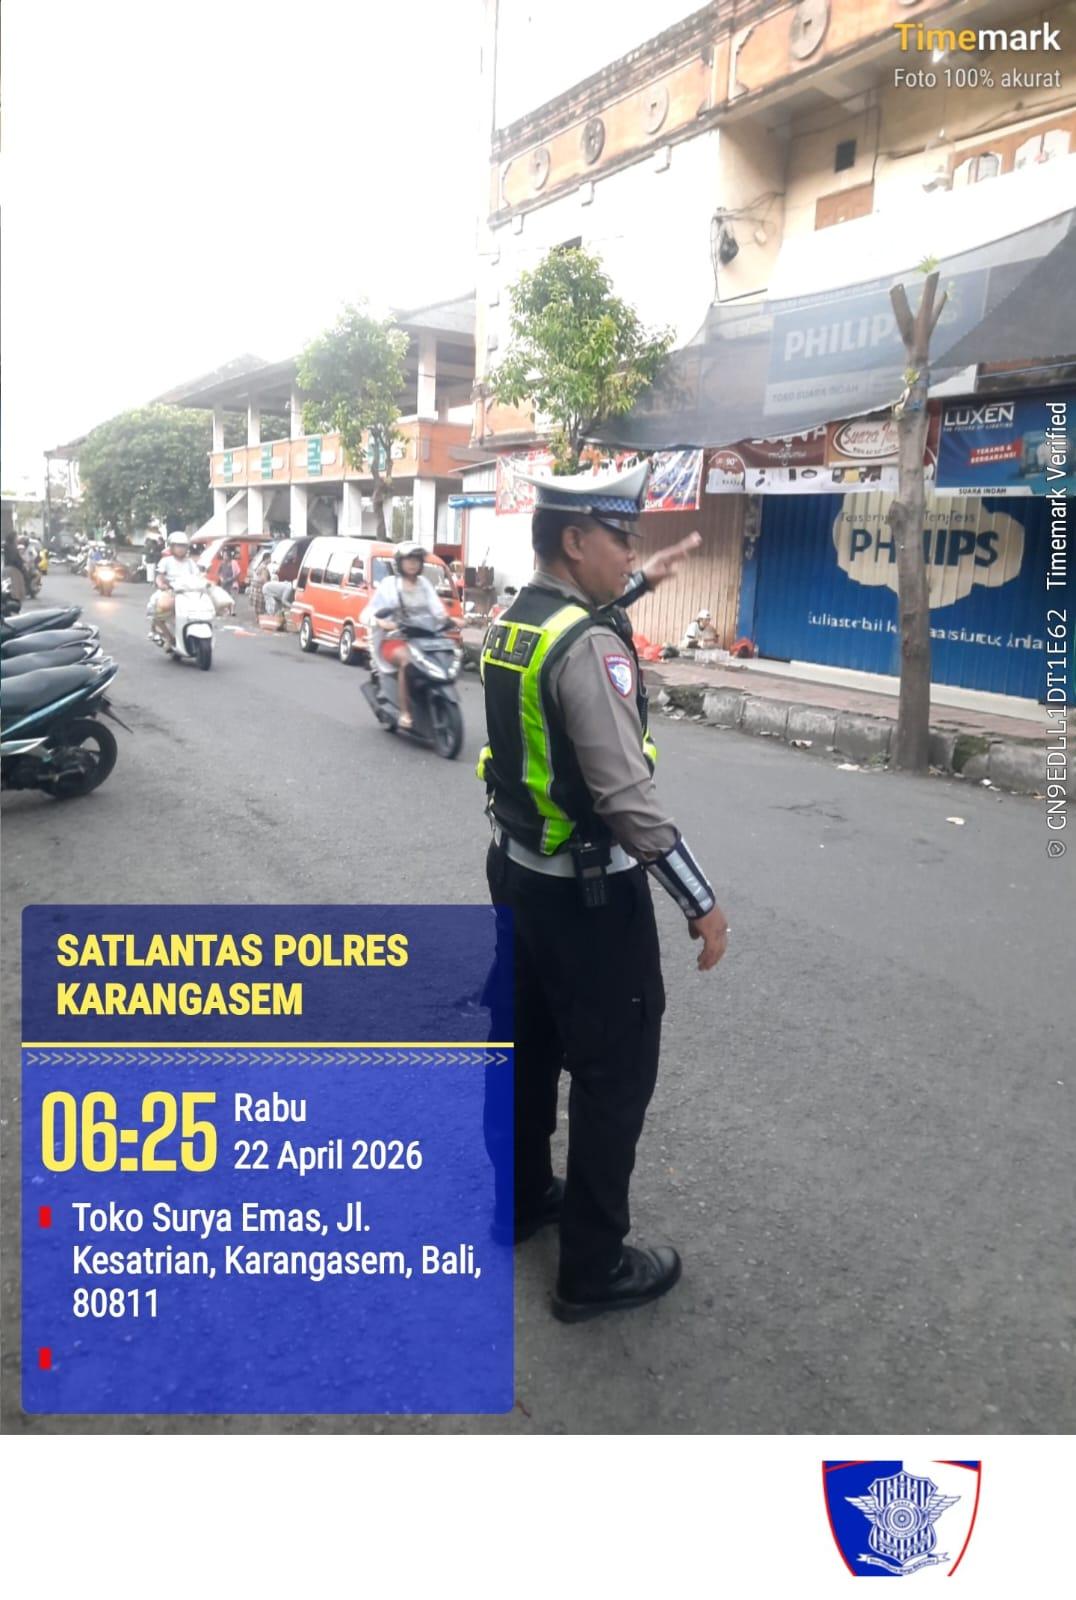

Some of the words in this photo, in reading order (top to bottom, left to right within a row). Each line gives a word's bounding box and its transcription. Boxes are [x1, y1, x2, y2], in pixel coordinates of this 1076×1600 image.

[784, 312, 904, 361] PHILIP
[943, 402, 1016, 426] LUXEN
[849, 529, 999, 567] PHIPS
